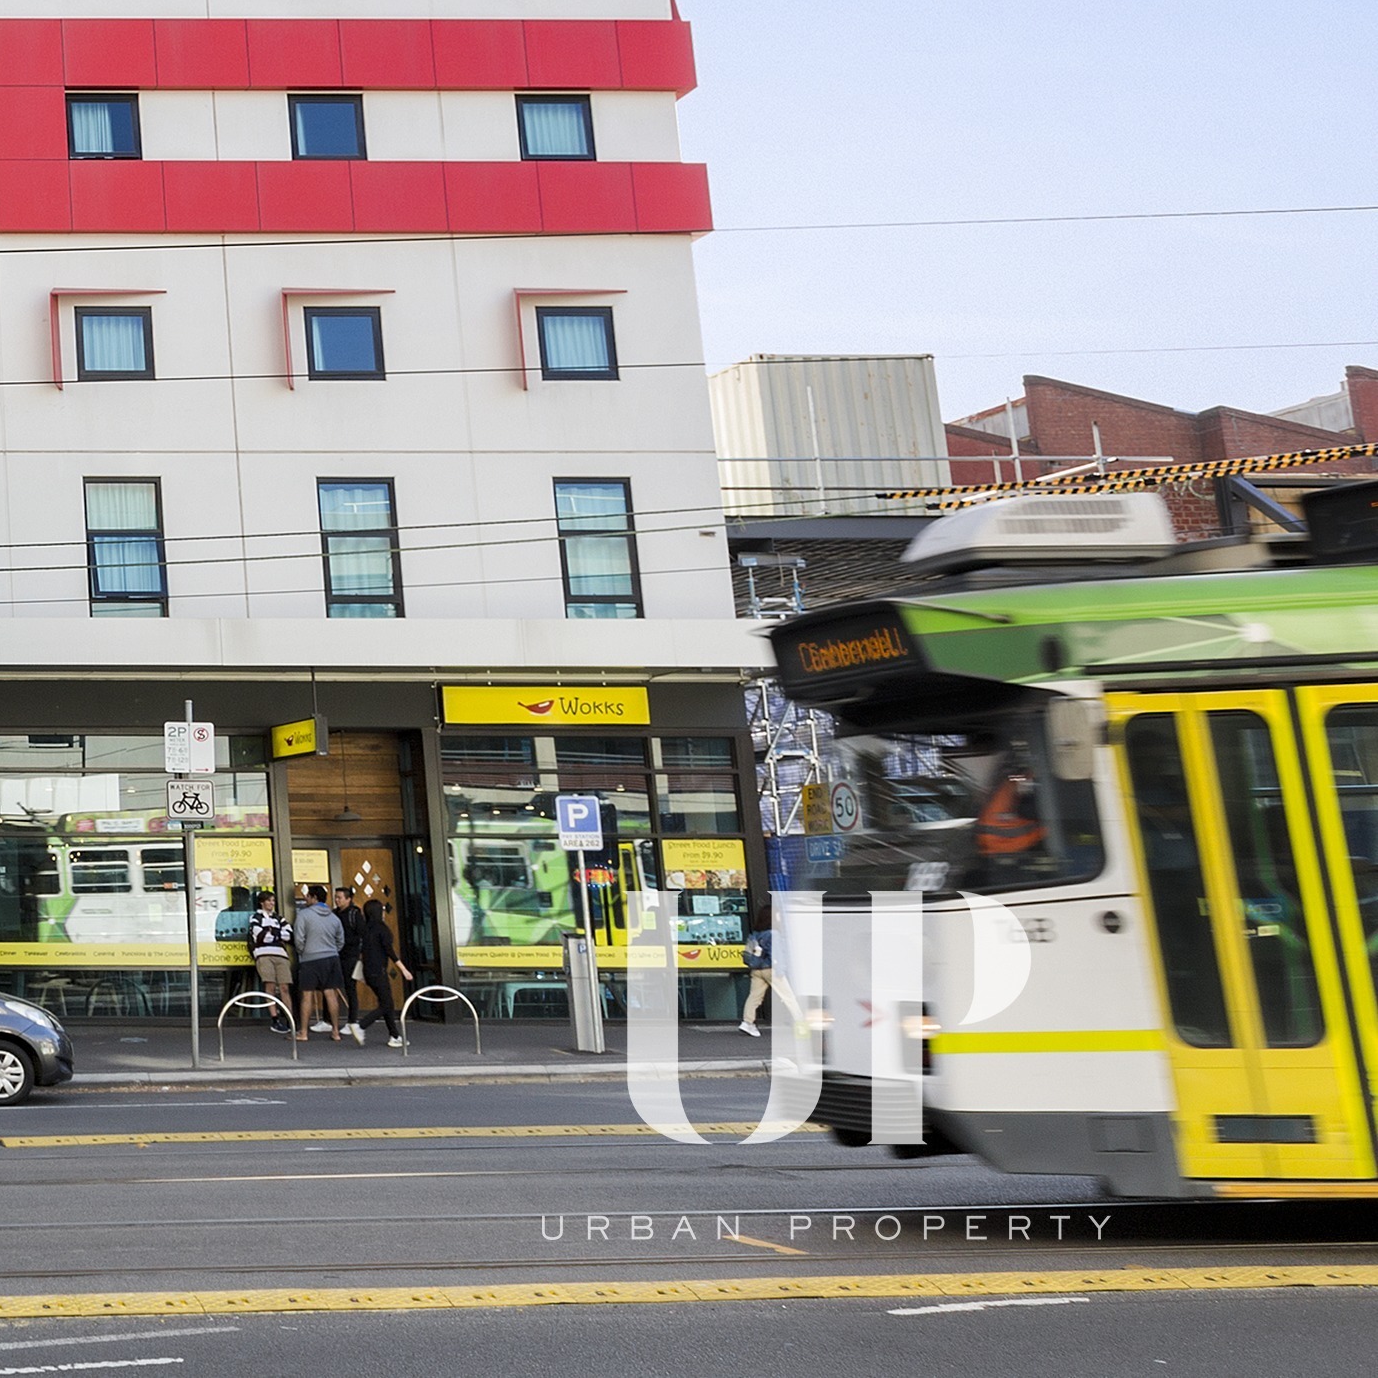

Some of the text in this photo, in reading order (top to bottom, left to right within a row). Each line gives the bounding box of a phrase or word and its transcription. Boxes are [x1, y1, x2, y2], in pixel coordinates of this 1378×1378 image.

[168, 726, 187, 738] 2P
[835, 796, 854, 818] 50
[567, 804, 589, 828] P
[691, 841, 710, 849] Food
[712, 841, 736, 849] Lunch
